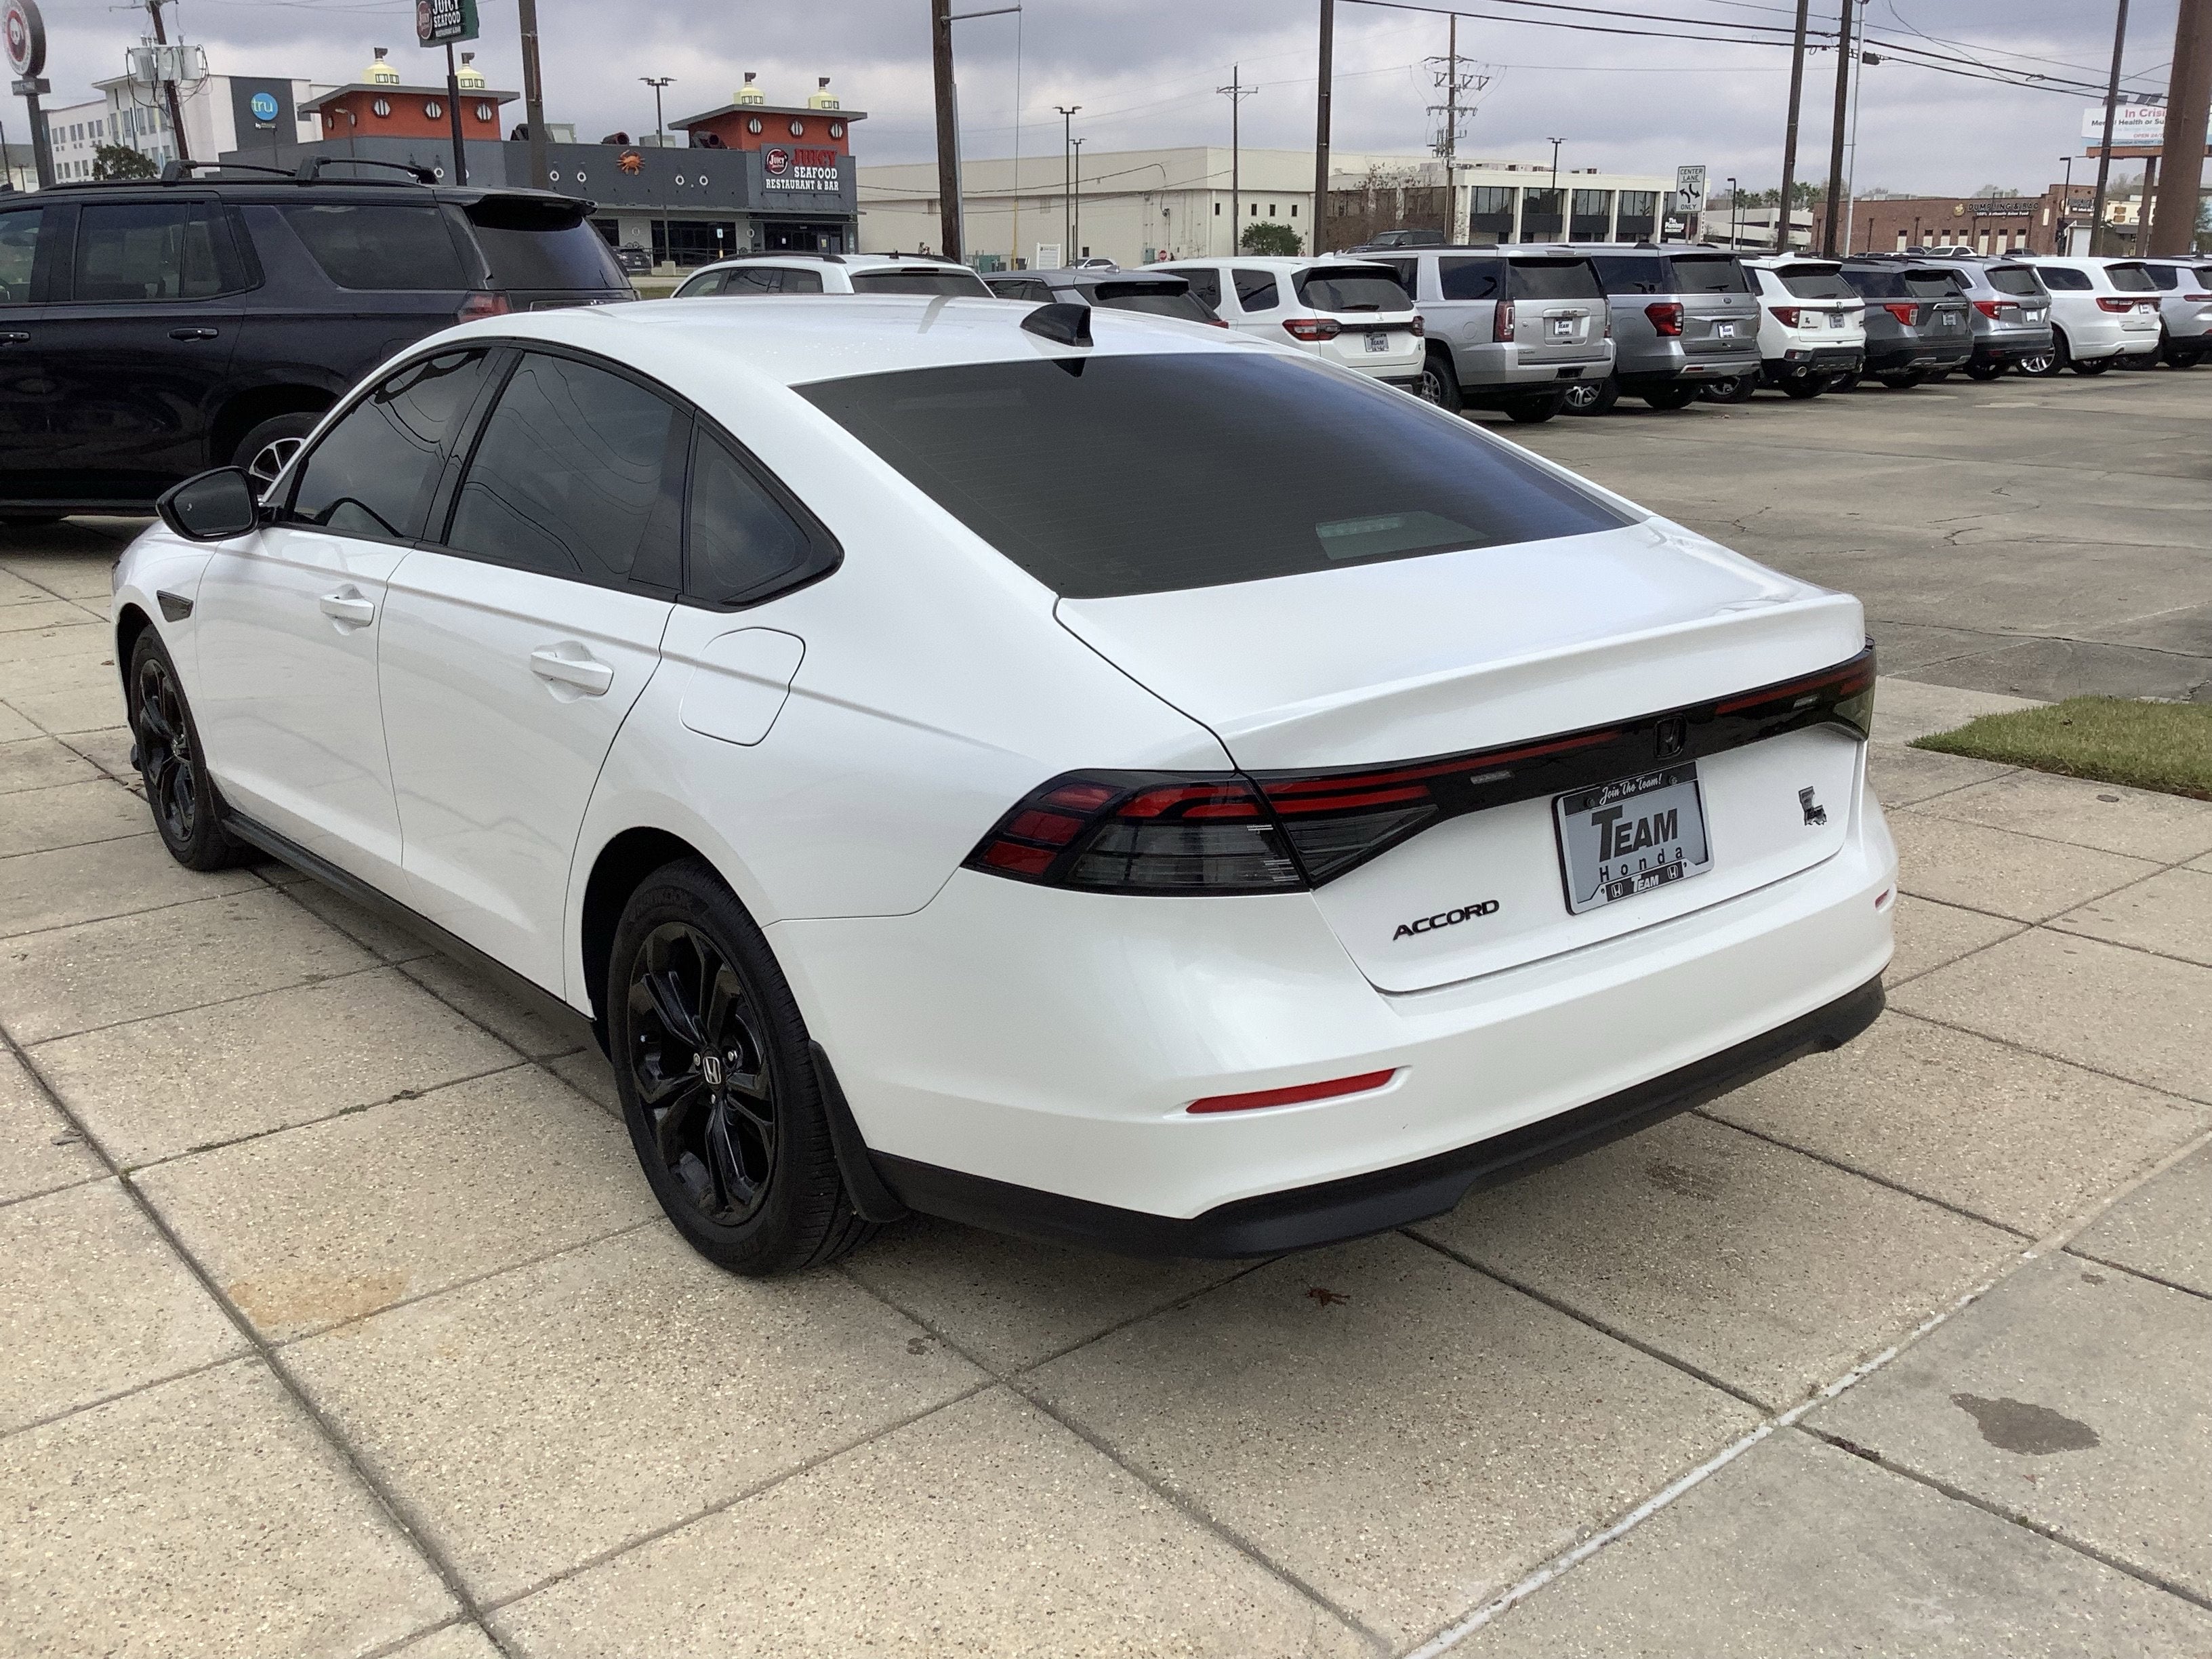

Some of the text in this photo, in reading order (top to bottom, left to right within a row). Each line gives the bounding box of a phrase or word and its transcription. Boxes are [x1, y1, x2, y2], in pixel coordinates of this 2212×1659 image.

[432, 0, 459, 14] JUICY
[434, 11, 461, 28] SEAFOOD
[251, 98, 273, 113] tru
[2125, 108, 2167, 118] In Crisi
[791, 148, 837, 167] JUICY
[794, 166, 838, 179] SEAFOOD
[765, 178, 839, 191] RESTAURANT & BAR
[2013, 203, 2020, 211] &
[1599, 773, 1663, 805] Join The Team!
[1591, 804, 1678, 863] TEAM
[1599, 846, 1683, 883] Honda
[1631, 875, 1659, 893] TEAM
[1393, 899, 1500, 941] ACCORD
